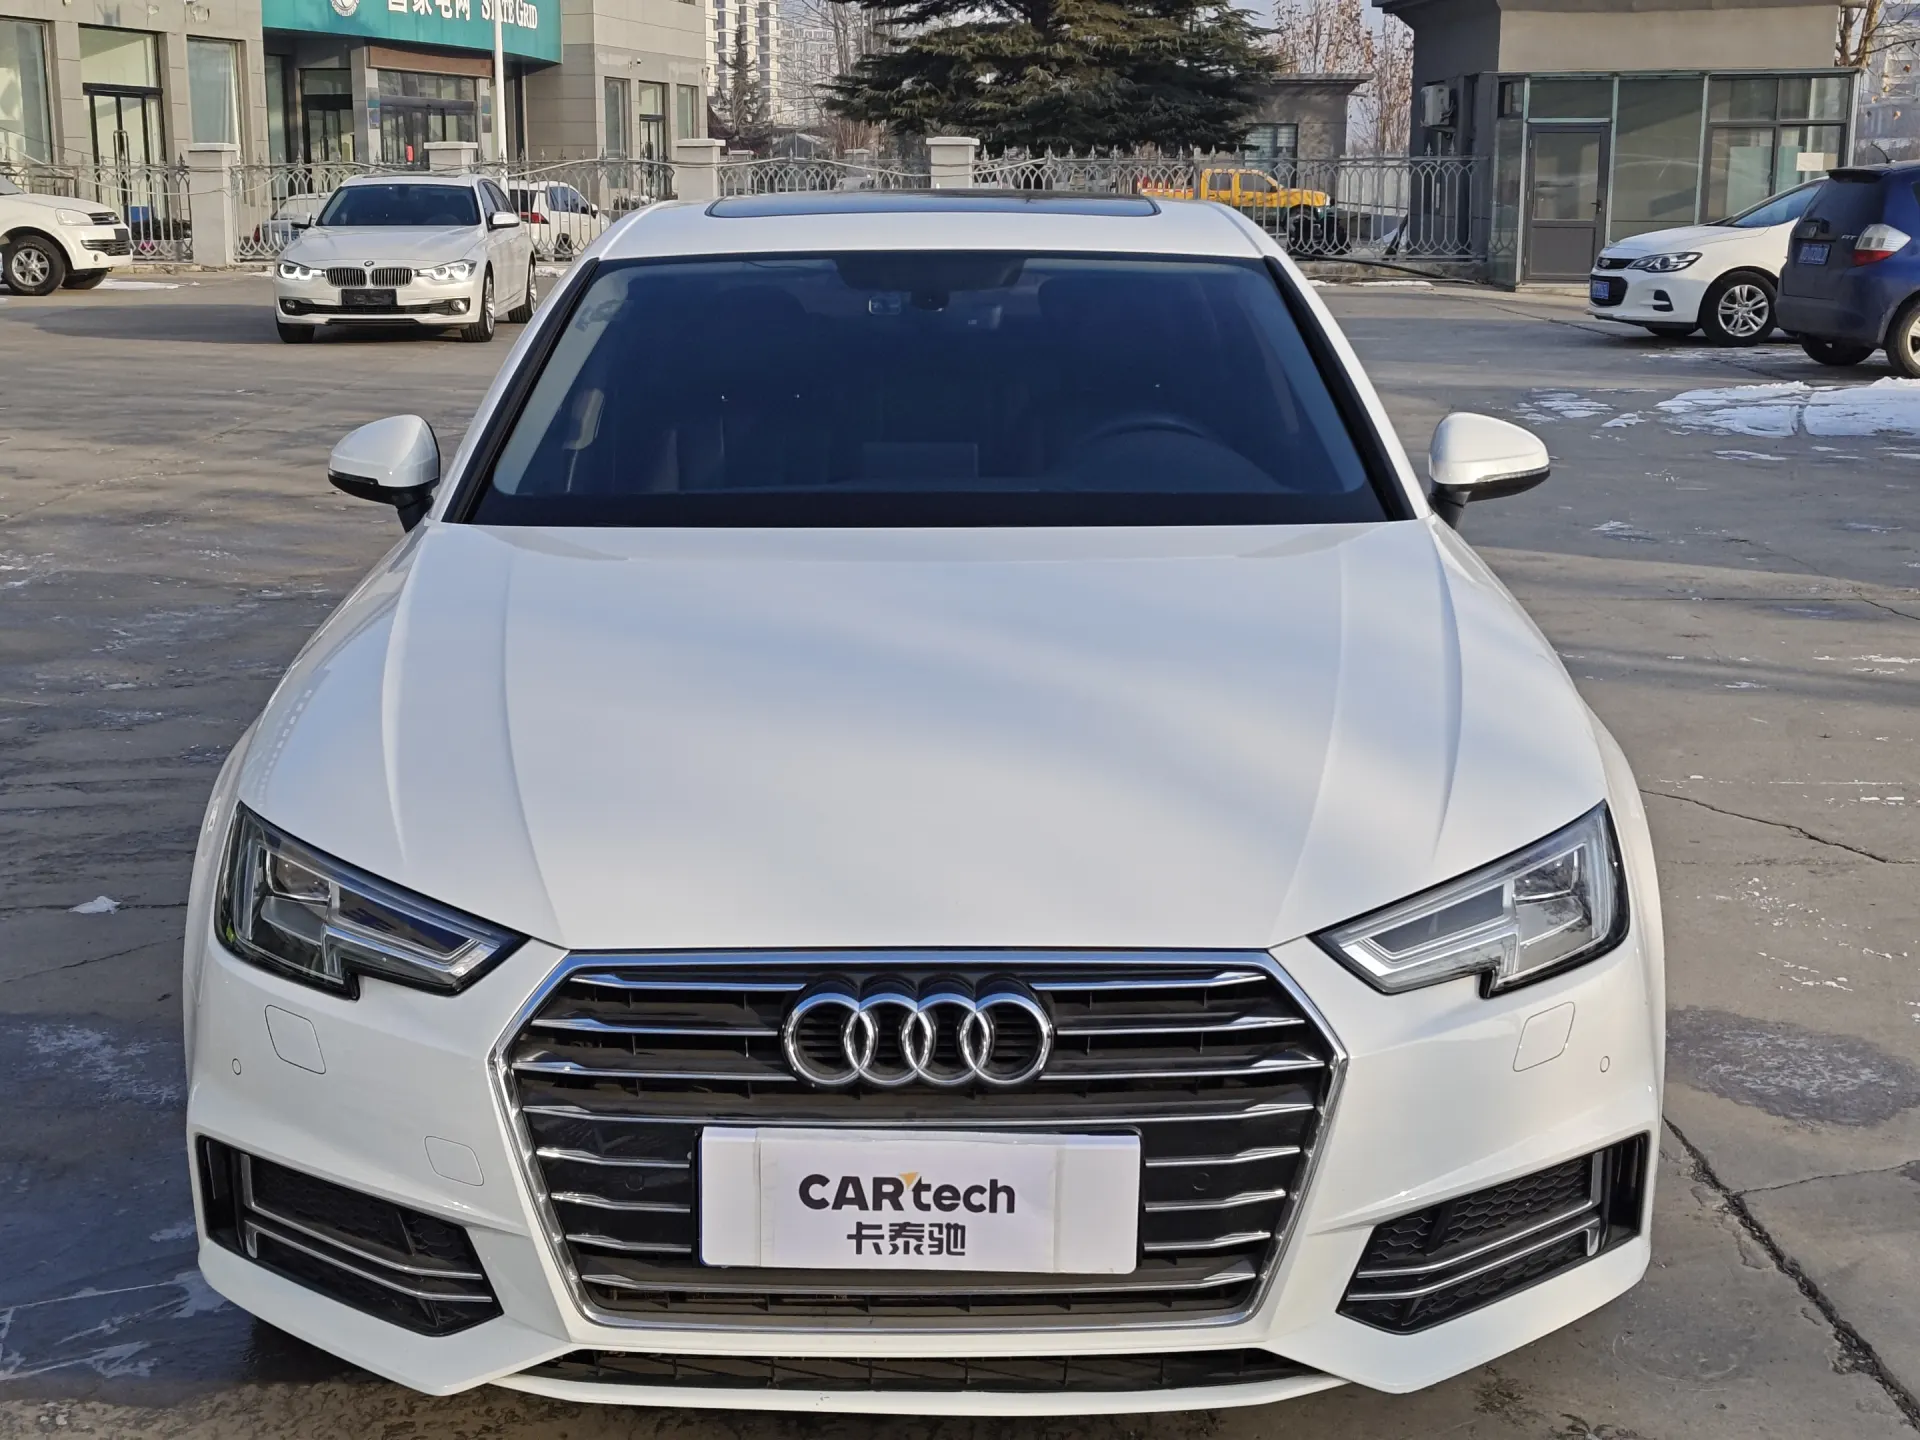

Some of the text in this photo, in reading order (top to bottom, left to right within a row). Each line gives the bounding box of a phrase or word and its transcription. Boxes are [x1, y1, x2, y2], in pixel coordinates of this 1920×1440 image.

[481, 0, 515, 24] STTE
[798, 1172, 1016, 1214] CARtech
[846, 1221, 966, 1256] 卡泰驰
